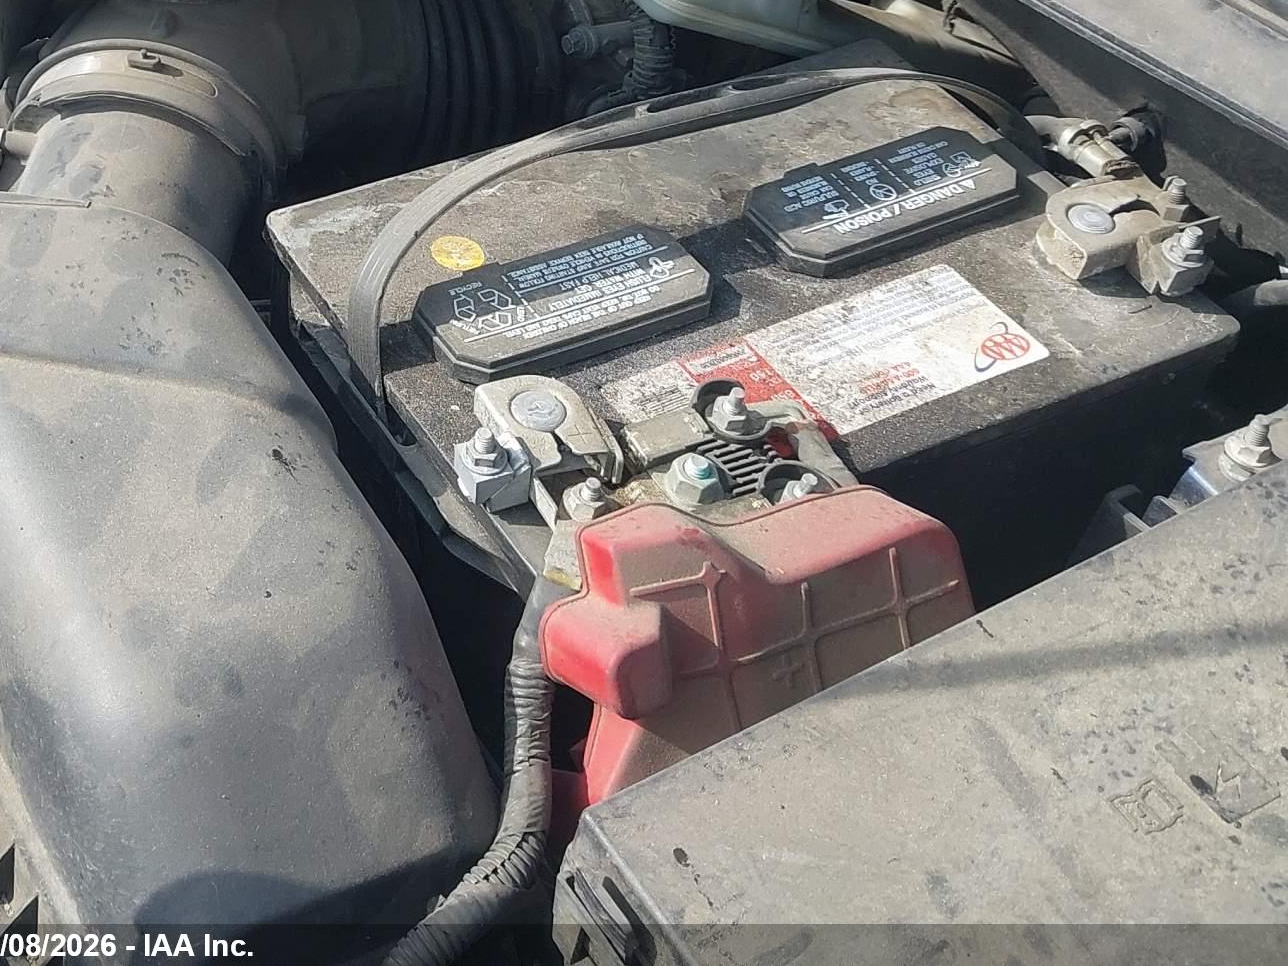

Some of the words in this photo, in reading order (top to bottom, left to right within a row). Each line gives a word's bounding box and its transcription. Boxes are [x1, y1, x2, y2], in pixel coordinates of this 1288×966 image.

[912, 168, 934, 179] EYES
[800, 189, 839, 206] SULFURIC
[899, 182, 965, 211] DANGER
[782, 201, 803, 212] ACID
[832, 207, 893, 234] POISON
[567, 255, 595, 266] VEHICLE
[601, 260, 639, 276] MEDICAL
[620, 267, 646, 279] WITH
[517, 277, 545, 289] FOLLOW
[578, 271, 604, 283] HELP
[623, 273, 652, 287] FLUSH
[447, 281, 483, 295] RECYCLE
[557, 278, 581, 290] FAST
[573, 283, 592, 294] GET
[601, 281, 625, 294] EYES
[546, 288, 602, 311] IMMEDIATELY
[981, 333, 1030, 361] AAA
